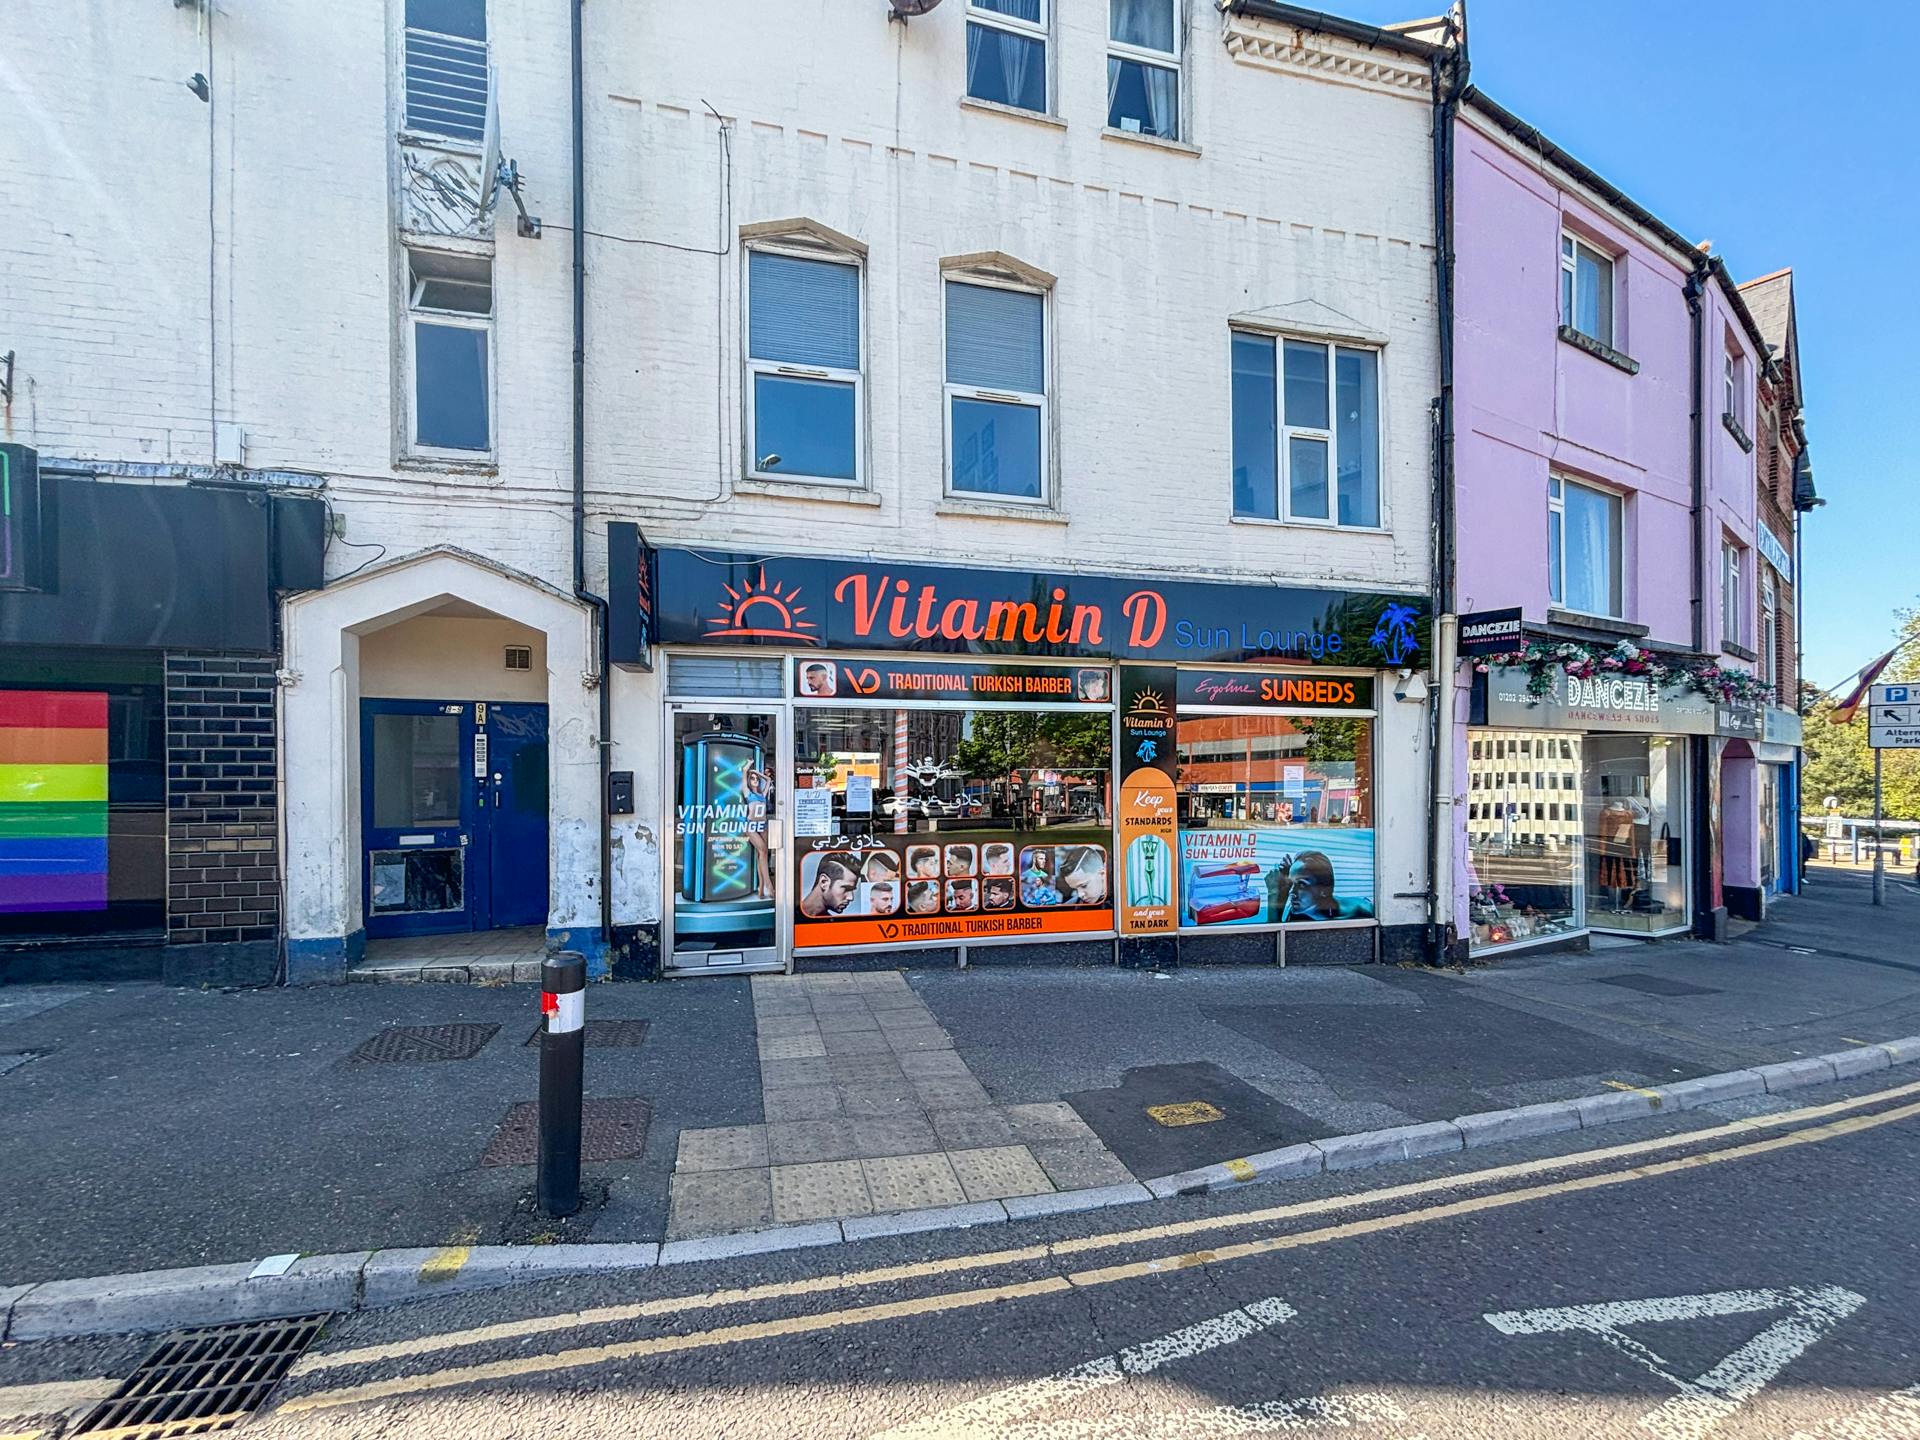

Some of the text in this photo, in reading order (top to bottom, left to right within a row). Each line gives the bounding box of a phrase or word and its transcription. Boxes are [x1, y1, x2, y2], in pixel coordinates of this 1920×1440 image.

[834, 573, 1342, 659] Vitamin D Sun Lounge
[1463, 620, 1520, 637] DANCEZIE
[888, 672, 969, 691] TRADITIONAL
[972, 675, 1023, 692] TURKISH
[1026, 676, 1072, 694] BARBER
[1260, 678, 1356, 704] SUNBEDS
[1891, 688, 1904, 701] P
[1123, 715, 1174, 729] Vitamin D
[1144, 729, 1167, 738] Lounge
[1133, 790, 1164, 808] Keep
[678, 804, 766, 819] VITAMIN D
[1156, 806, 1173, 817] your
[676, 821, 766, 835] SUN LOUNGE
[1125, 817, 1172, 826] STANDARDS
[812, 833, 886, 851] حلاق عربي
[1185, 833, 1257, 847] VITAMIN D
[1185, 847, 1257, 859] SUN LOUNGE
[1133, 908, 1165, 919] and your
[902, 921, 963, 936] TRADITIONAL
[966, 919, 1005, 934] TURKISH
[1007, 917, 1043, 932] BARBER
[1129, 919, 1169, 929] TAN DARK
